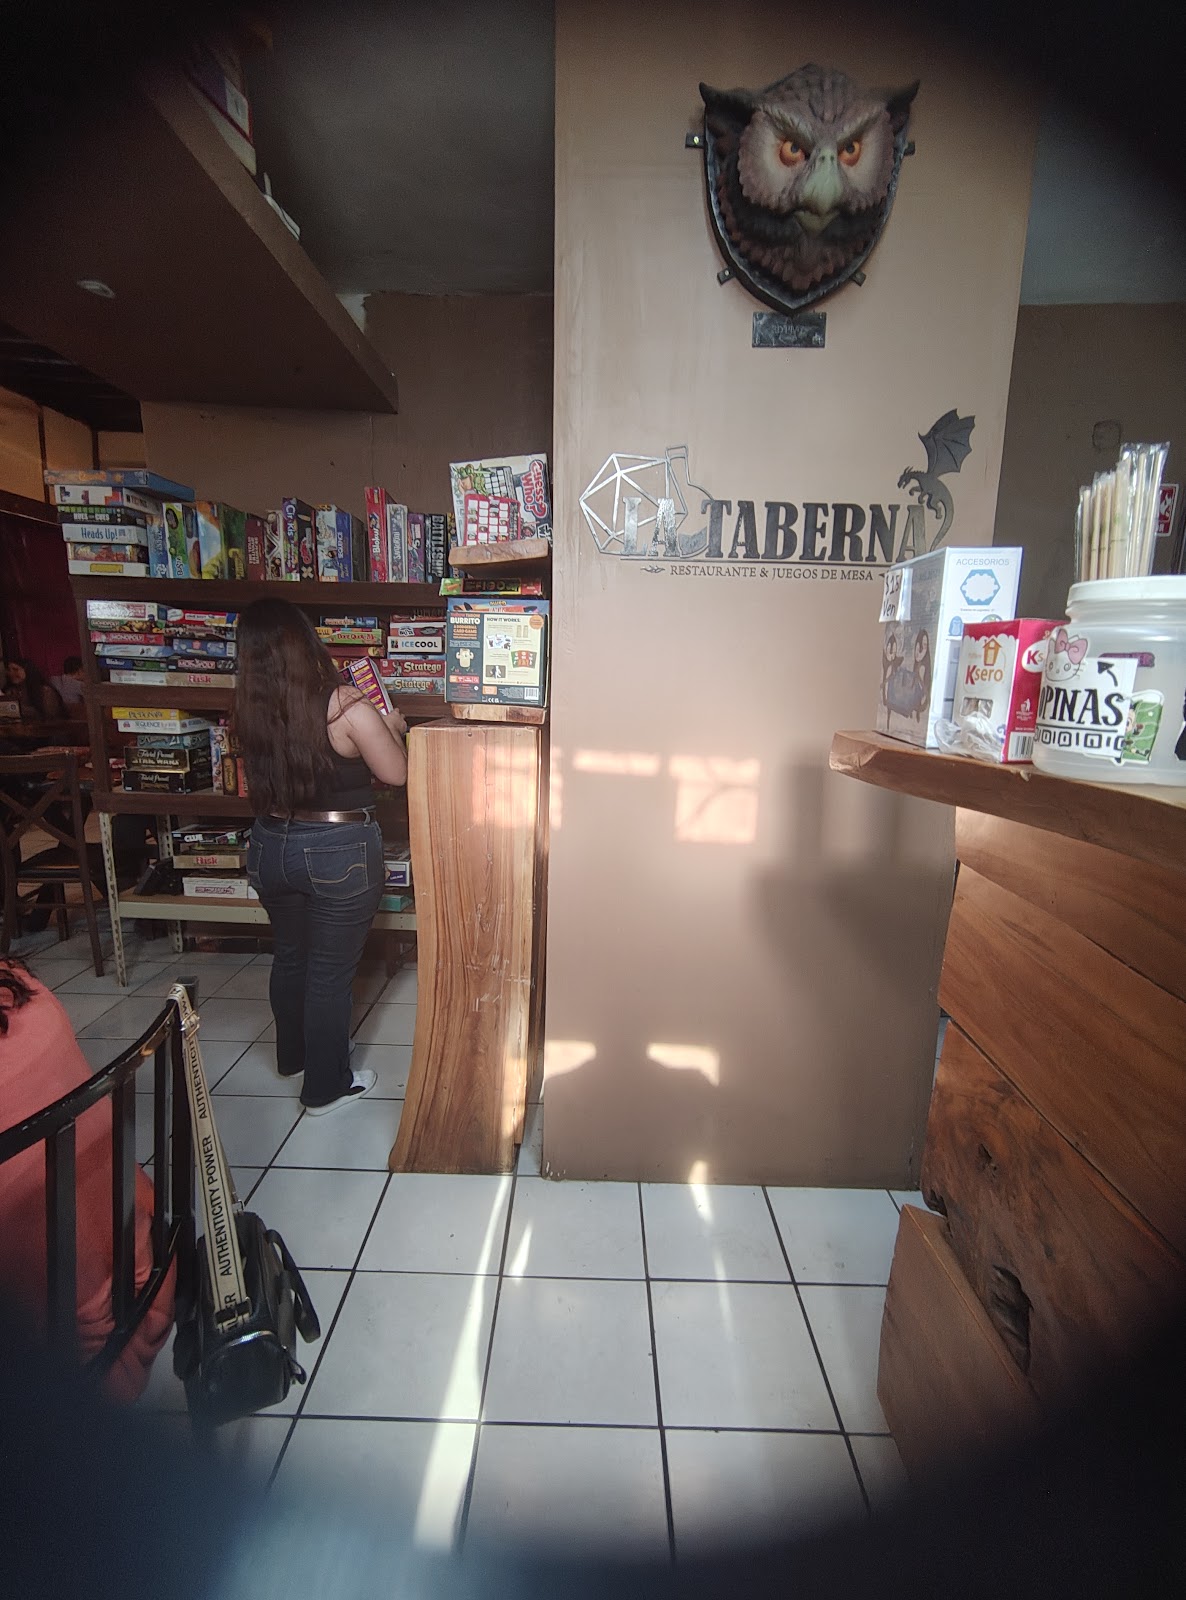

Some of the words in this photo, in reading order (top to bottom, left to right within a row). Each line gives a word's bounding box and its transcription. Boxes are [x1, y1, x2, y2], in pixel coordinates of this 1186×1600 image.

[80, 527, 103, 540] Heads
[105, 527, 118, 542] Up!
[622, 497, 680, 557] LA
[700, 499, 928, 564] TABERNA
[431, 515, 444, 577] BATTLESHIP
[956, 558, 1010, 566] ACCESORIOS
[670, 564, 757, 578] RESTAURANTE
[760, 567, 769, 578] &
[771, 567, 819, 581] JUEGOS
[821, 568, 838, 579] DE
[840, 569, 873, 581] MESA
[450, 616, 480, 625] BURRITO
[110, 633, 144, 641] MONOPOLY
[403, 661, 442, 674] Stratego
[965, 664, 1003, 686] Ksero
[188, 674, 212, 684] Risk
[196, 856, 218, 865] Risk
[189, 1041, 208, 1119] AUTHENTICIT
[202, 1134, 218, 1185] POWER
[208, 1188, 232, 1277] AUTHENTICITY
